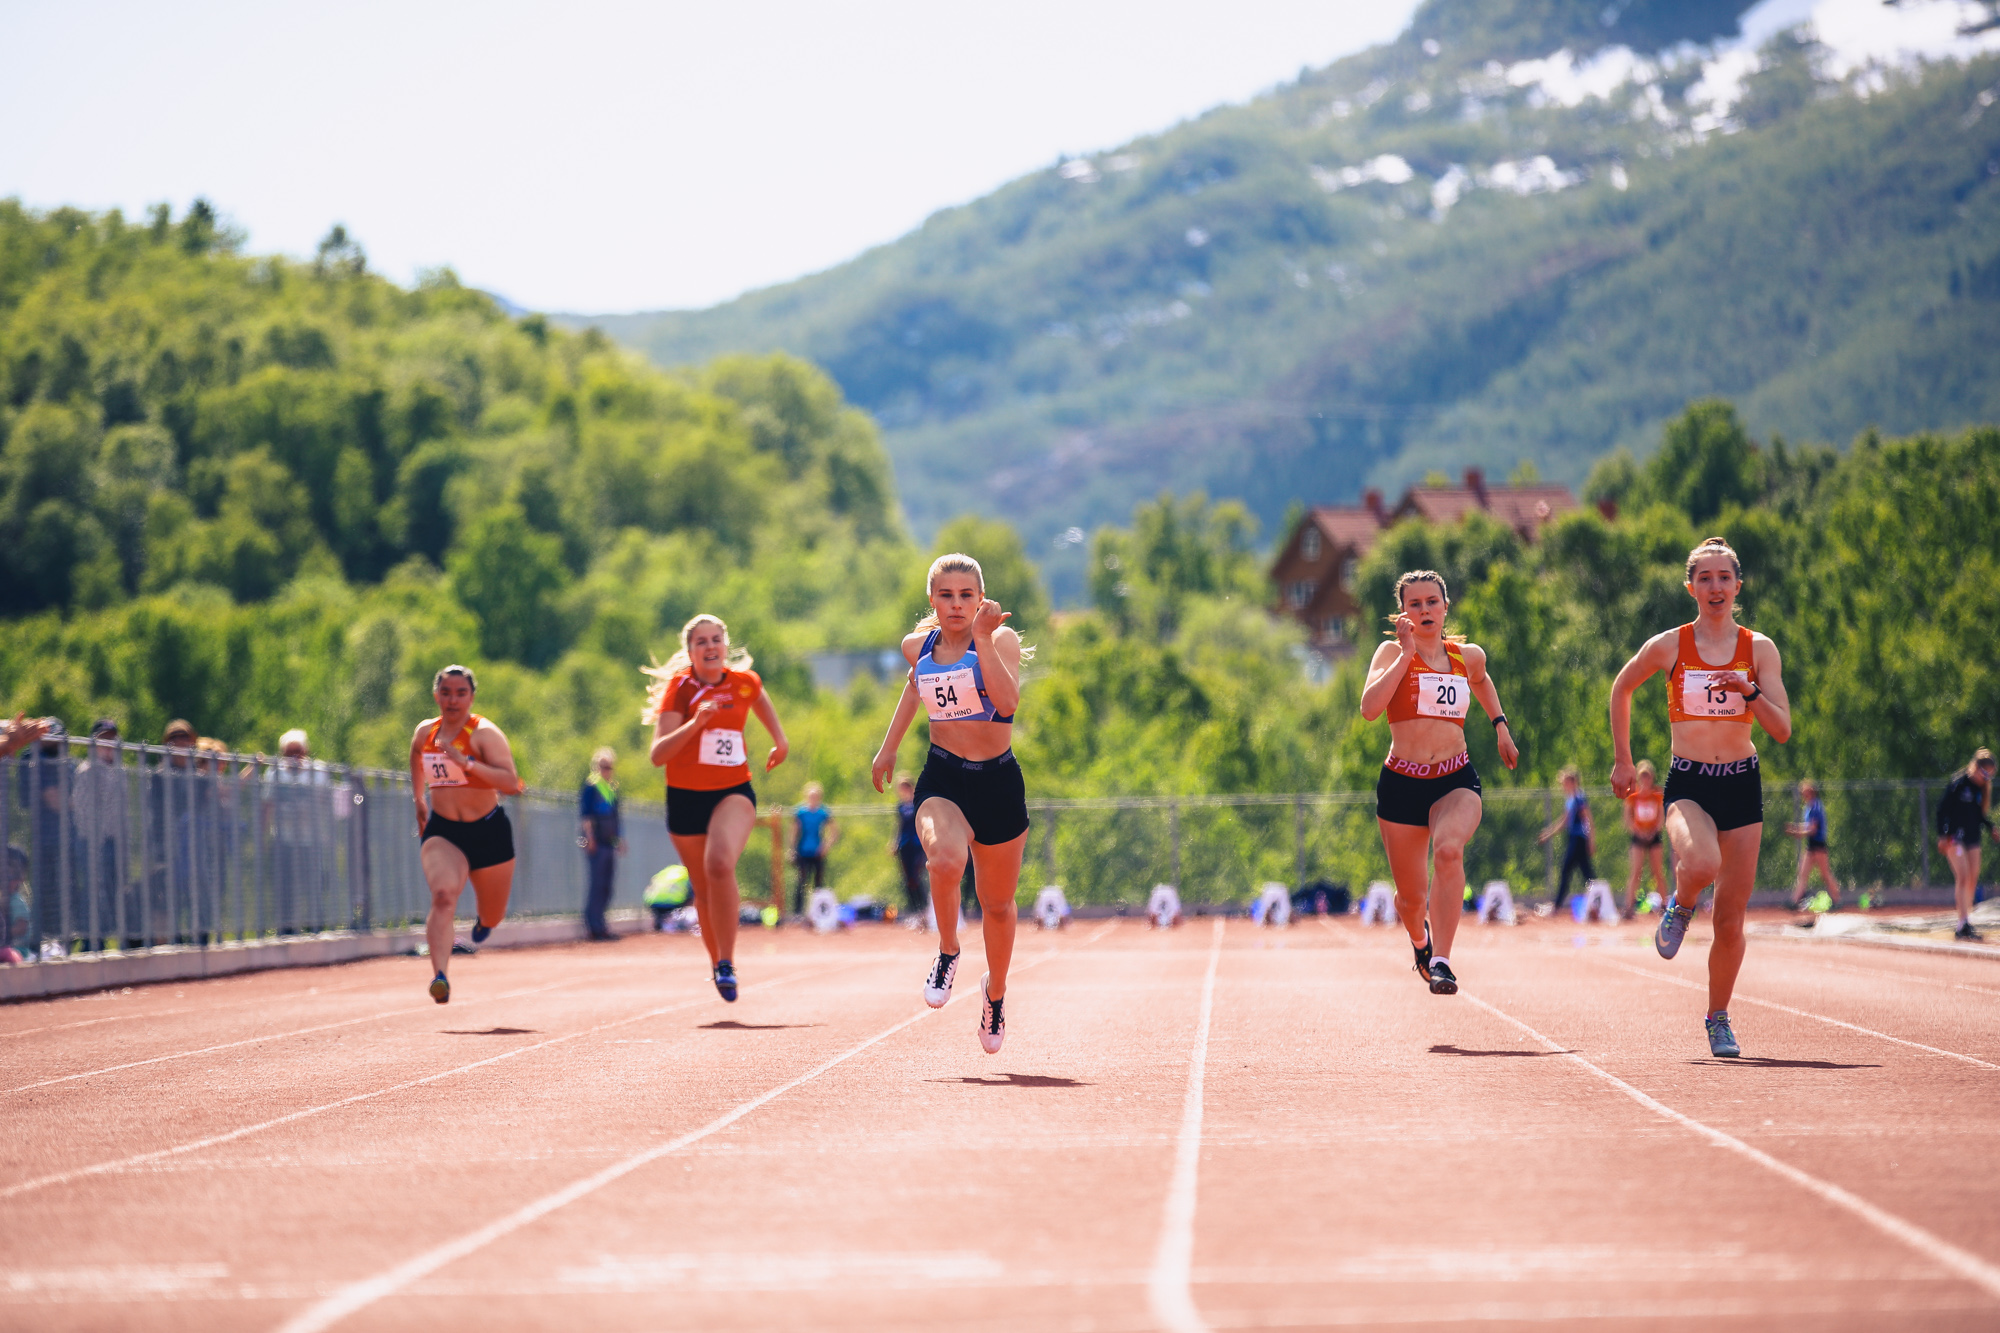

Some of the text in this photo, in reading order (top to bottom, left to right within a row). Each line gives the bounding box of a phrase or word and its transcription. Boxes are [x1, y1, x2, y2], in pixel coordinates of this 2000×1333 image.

[935, 685, 958, 708] 54
[1436, 685, 1456, 705] 20
[1704, 683, 1727, 704] 13
[954, 708, 972, 718] HIND
[716, 739, 732, 756] 29
[432, 763, 448, 778] 33
[1394, 759, 1430, 776] PRO
[1437, 751, 1469, 775] NIKE
[1698, 759, 1747, 776] NIKE
